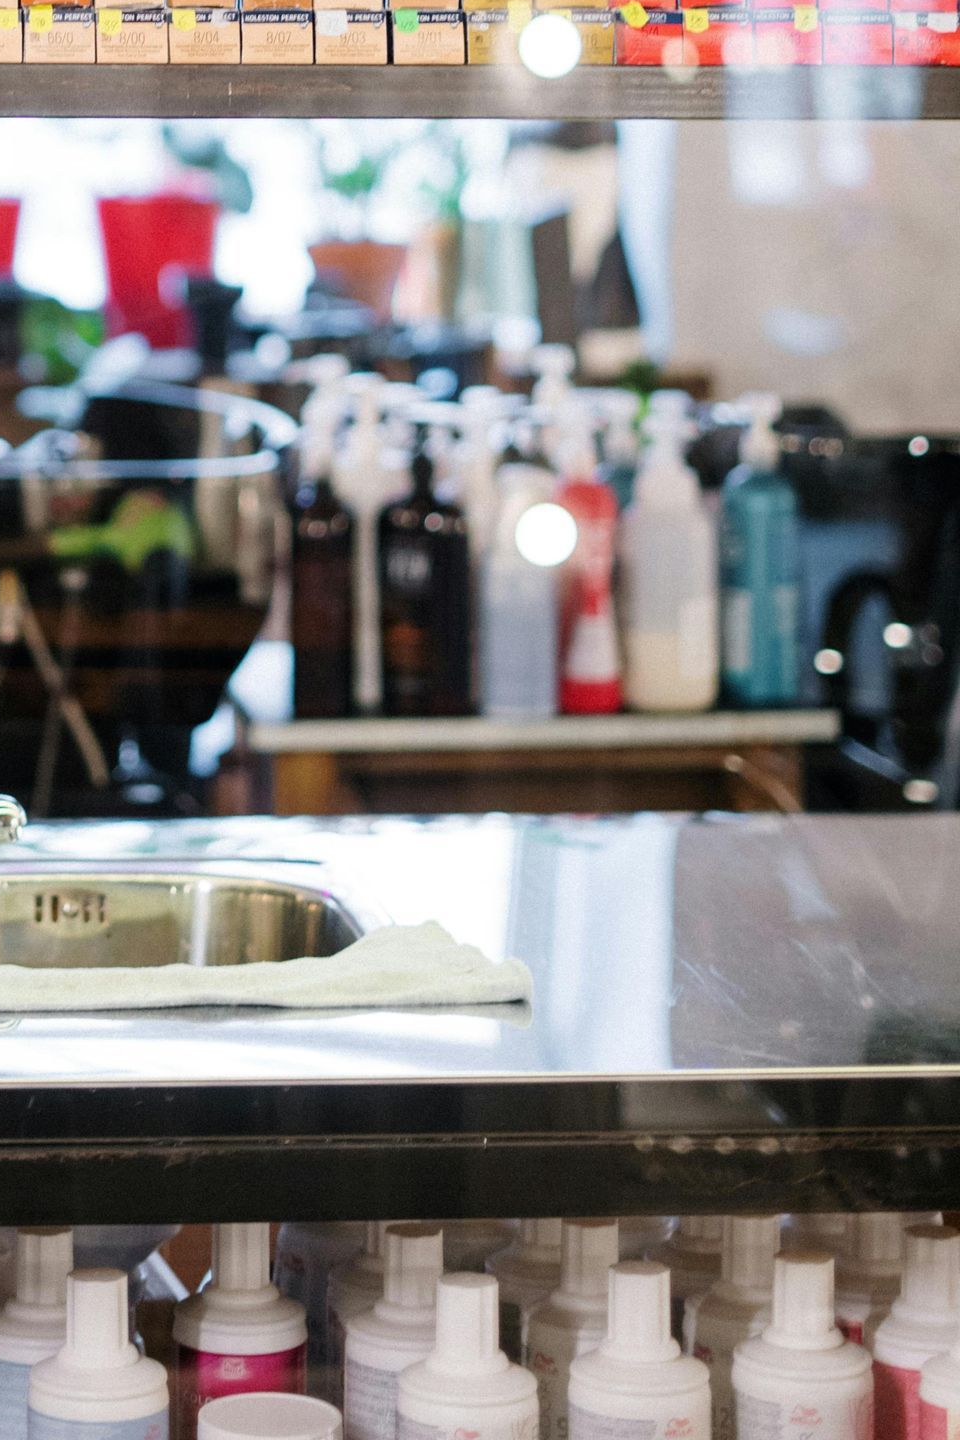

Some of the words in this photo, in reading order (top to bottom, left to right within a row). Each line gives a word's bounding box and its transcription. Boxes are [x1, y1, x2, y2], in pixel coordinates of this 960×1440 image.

[245, 14, 276, 22] KOLESTON
[279, 14, 309, 22] PERFECT
[193, 32, 218, 43] 8/04
[267, 33, 291, 44] 8/07
[340, 32, 366, 44] 9/03
[418, 32, 441, 44] 9/01
